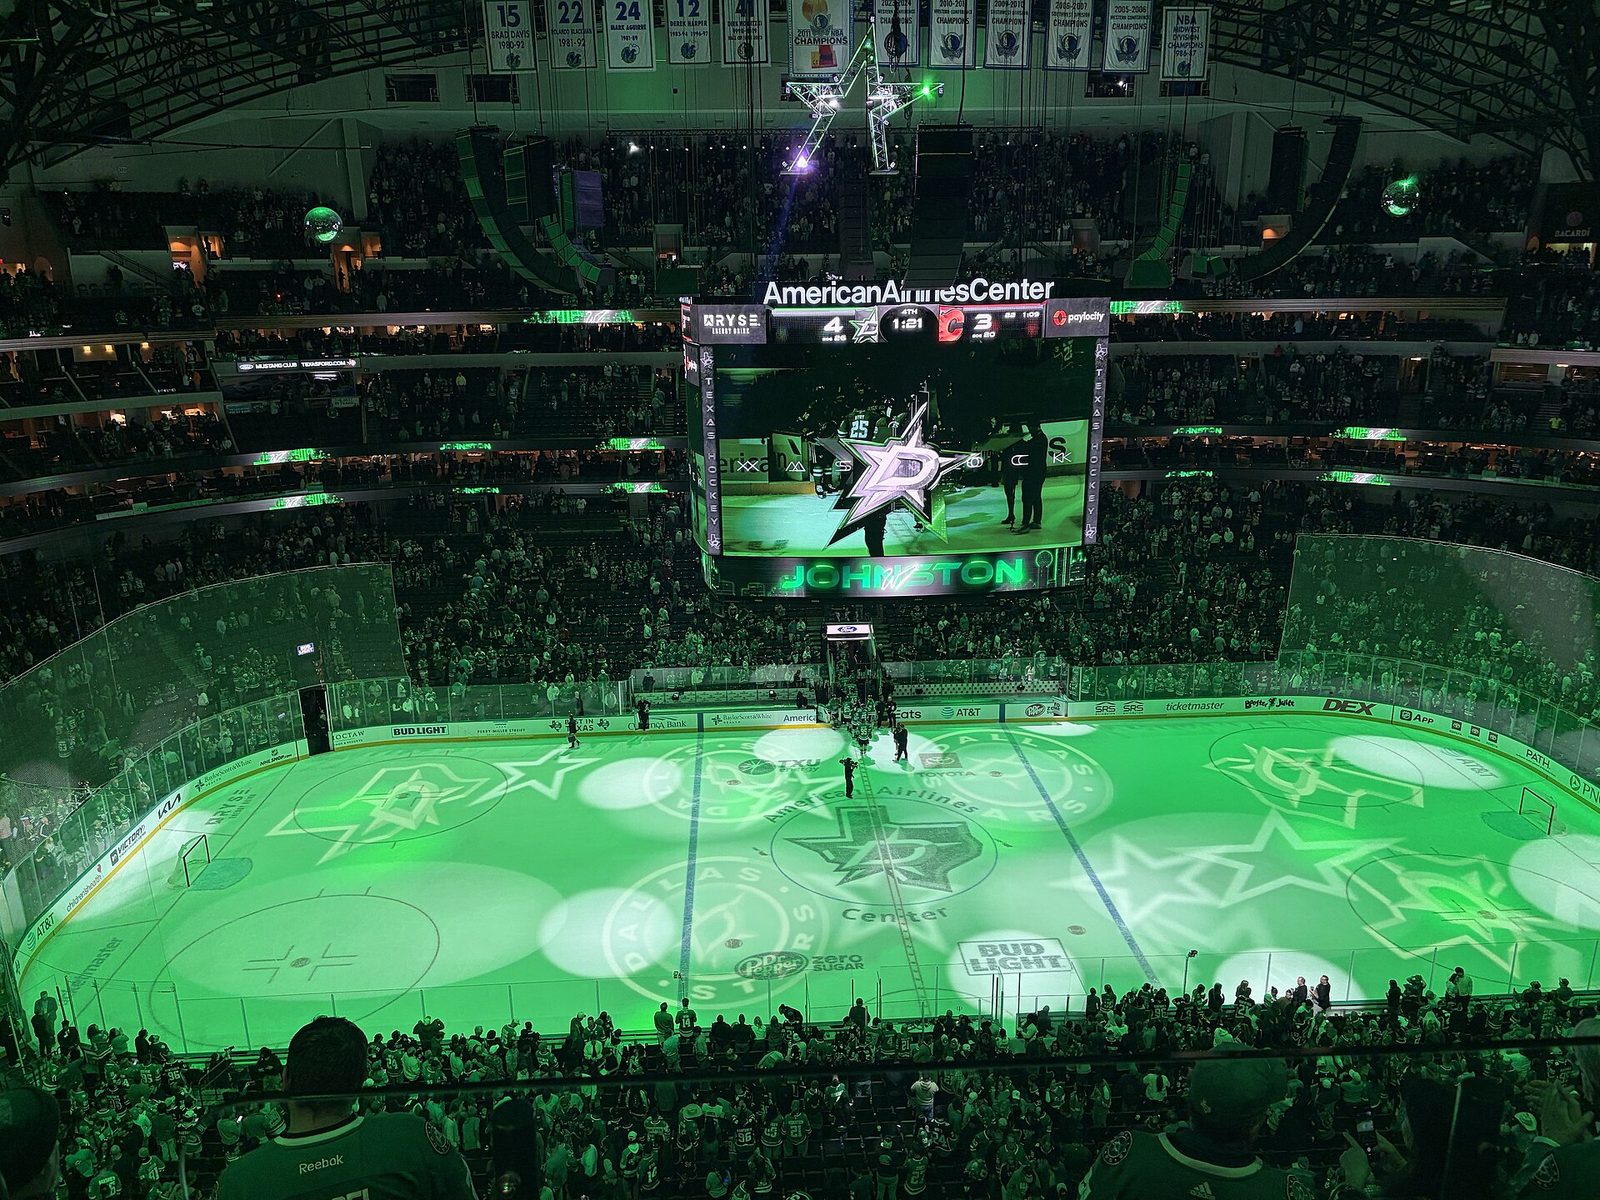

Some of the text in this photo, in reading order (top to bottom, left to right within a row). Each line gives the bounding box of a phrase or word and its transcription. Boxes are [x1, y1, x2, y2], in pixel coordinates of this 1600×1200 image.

[558, 1, 584, 24] 22
[615, 1, 641, 21] 24
[677, 0, 700, 18] 12
[497, 5, 521, 28] 15
[880, 17, 913, 25] CHAIONS
[1176, 14, 1197, 25] NBA
[1053, 19, 1088, 28] CHAMPIONS
[1111, 22, 1148, 31] CHAMPIONS
[1173, 25, 1201, 34] MIDWEST
[491, 29, 530, 39] BRAD DAVIS
[797, 28, 844, 37] 2011 NBA
[794, 36, 849, 46] CHAMPIONS
[1167, 41, 1204, 49] CHAMPIONS
[892, 317, 923, 329] 1:21
[973, 313, 994, 330] 3
[1067, 312, 1106, 325] paylocity
[823, 316, 845, 334] 4
[283, 361, 298, 369] CLUB
[1091, 368, 1103, 431] TEXAS
[704, 377, 716, 440] TEXAS
[850, 419, 870, 439] 25
[1173, 427, 1223, 435] JOHNSTON
[440, 442, 492, 451] JOHNSTON
[1087, 442, 1098, 516] HOCKEY
[707, 452, 718, 526] HOCKEY
[781, 558, 1025, 590] JOHNSTON
[956, 707, 981, 717] AT&T
[1095, 705, 1116, 713] SRS
[1123, 704, 1144, 712] SRS
[1166, 701, 1224, 711] ticketmaster
[1322, 698, 1377, 716] DEX
[667, 720, 687, 728] Bank
[393, 726, 447, 736] BUD LIGHT
[778, 758, 821, 768] TXU
[1525, 748, 1551, 769] PATH
[917, 770, 976, 778] TOYOTA
[157, 792, 182, 820] KIA
[876, 786, 980, 814] Airlines
[842, 906, 950, 924] Center
[36, 912, 55, 940] AT&T
[977, 942, 1045, 957] BUD
[811, 953, 864, 965] zero
[969, 954, 1062, 972] LIGHT
[814, 962, 865, 972] SUGAR
[299, 1154, 344, 1175] Reebok
